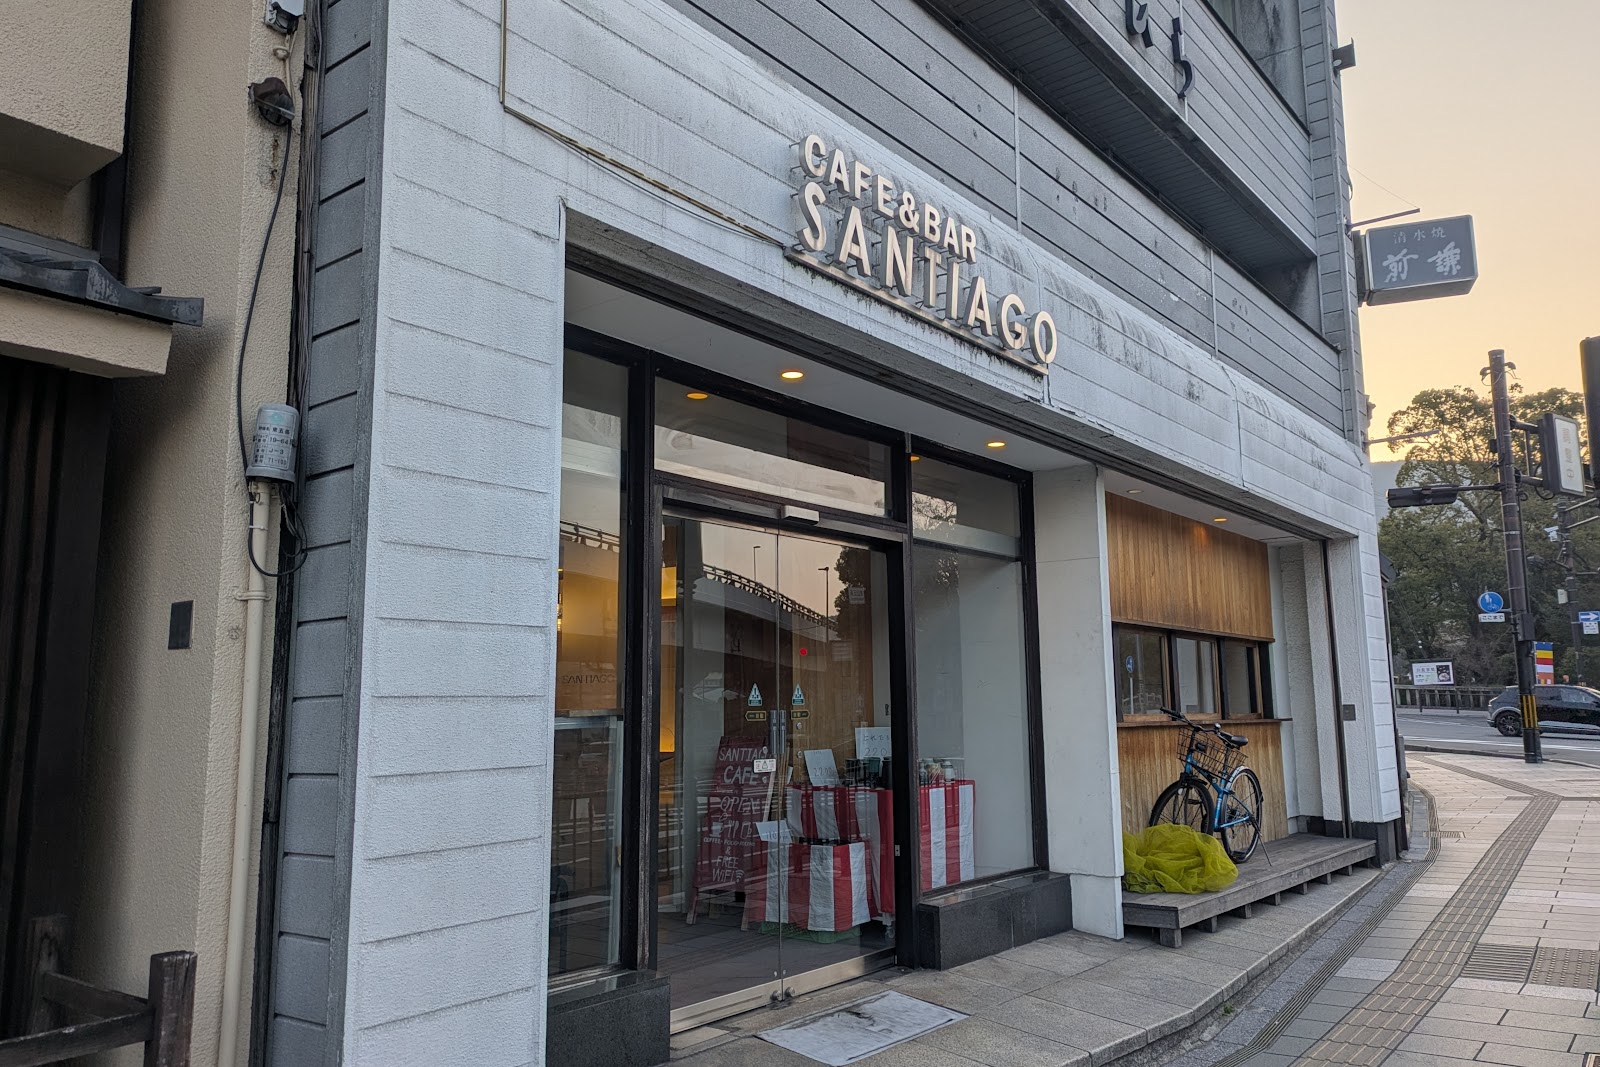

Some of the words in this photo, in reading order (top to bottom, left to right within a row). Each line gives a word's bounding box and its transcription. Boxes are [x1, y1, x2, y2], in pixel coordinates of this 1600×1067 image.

[800, 134, 977, 264] CAFE&BAR
[798, 181, 1058, 365] SANTIAGO
[723, 765, 759, 786] CAFE
[715, 856, 738, 869] FREE
